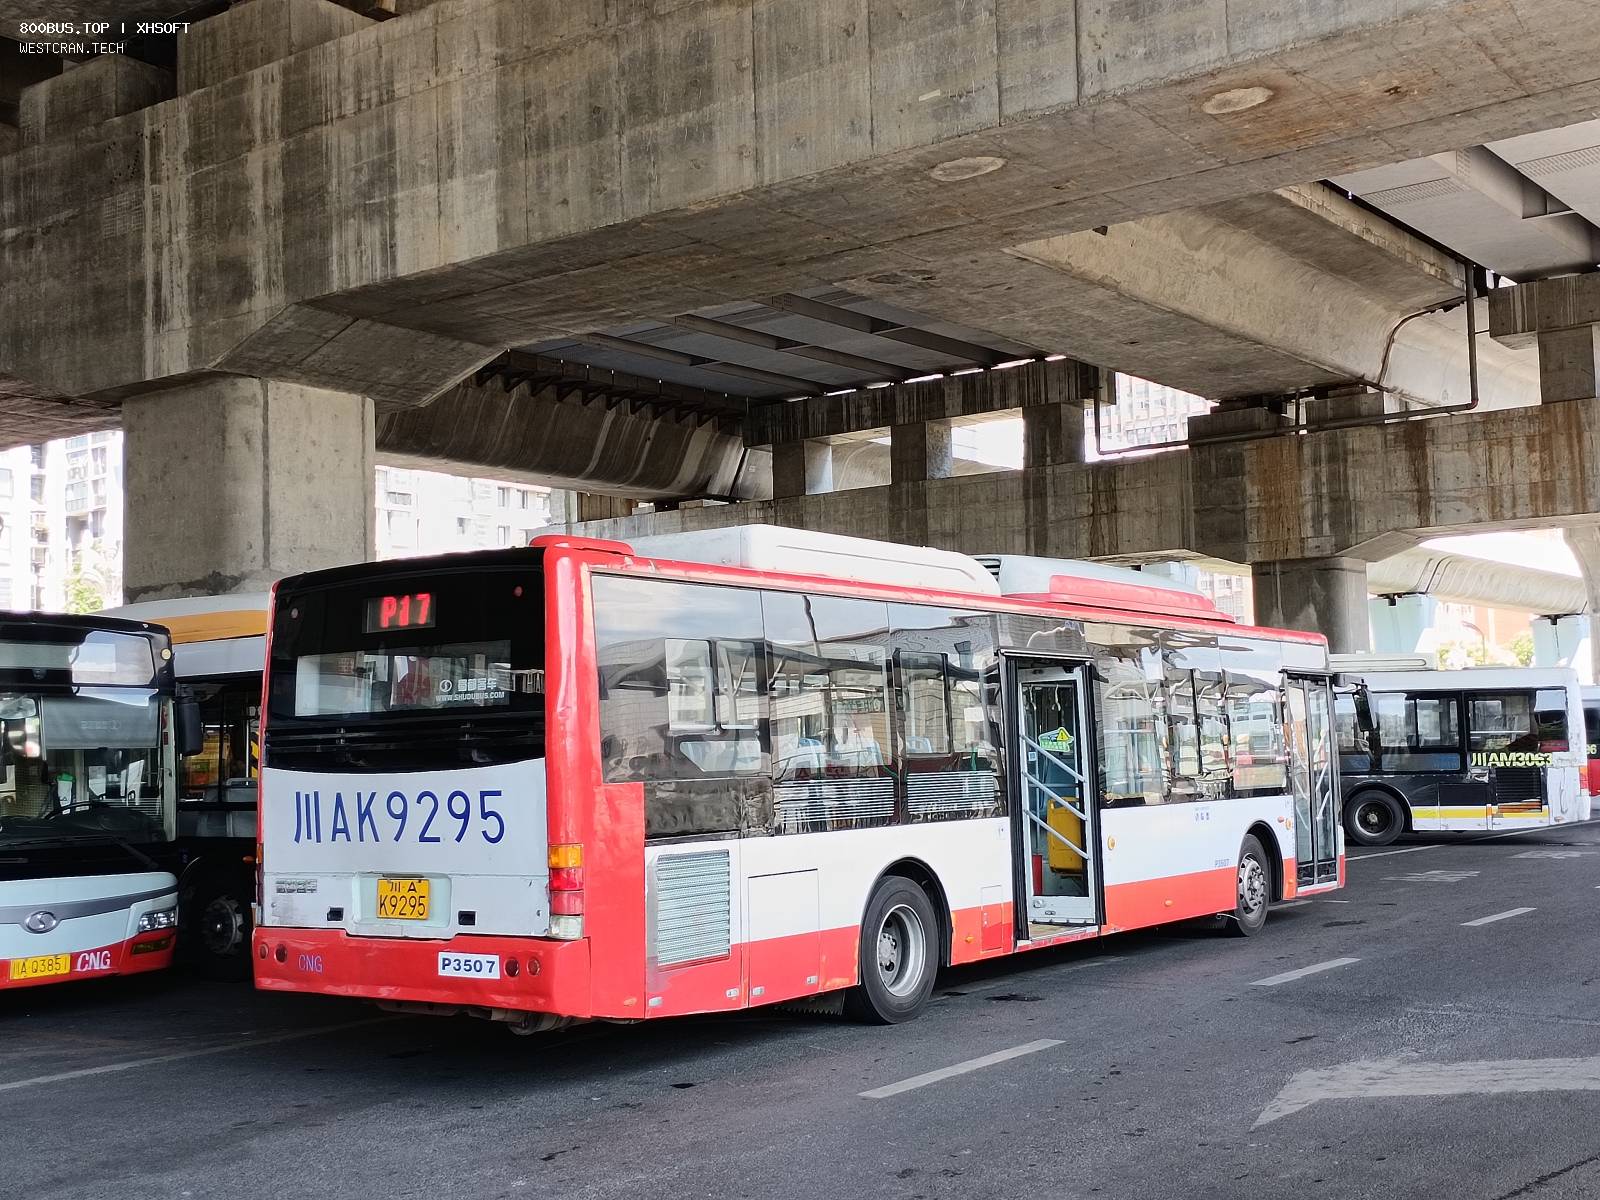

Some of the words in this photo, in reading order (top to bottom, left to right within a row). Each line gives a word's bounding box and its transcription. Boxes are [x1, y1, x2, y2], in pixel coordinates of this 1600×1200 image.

[381, 593, 431, 628] P17
[294, 790, 505, 843] 川AK9295
[379, 895, 426, 916] K9295
[77, 950, 111, 972] CNG
[298, 954, 323, 973] CNG
[441, 957, 496, 973] P3507
